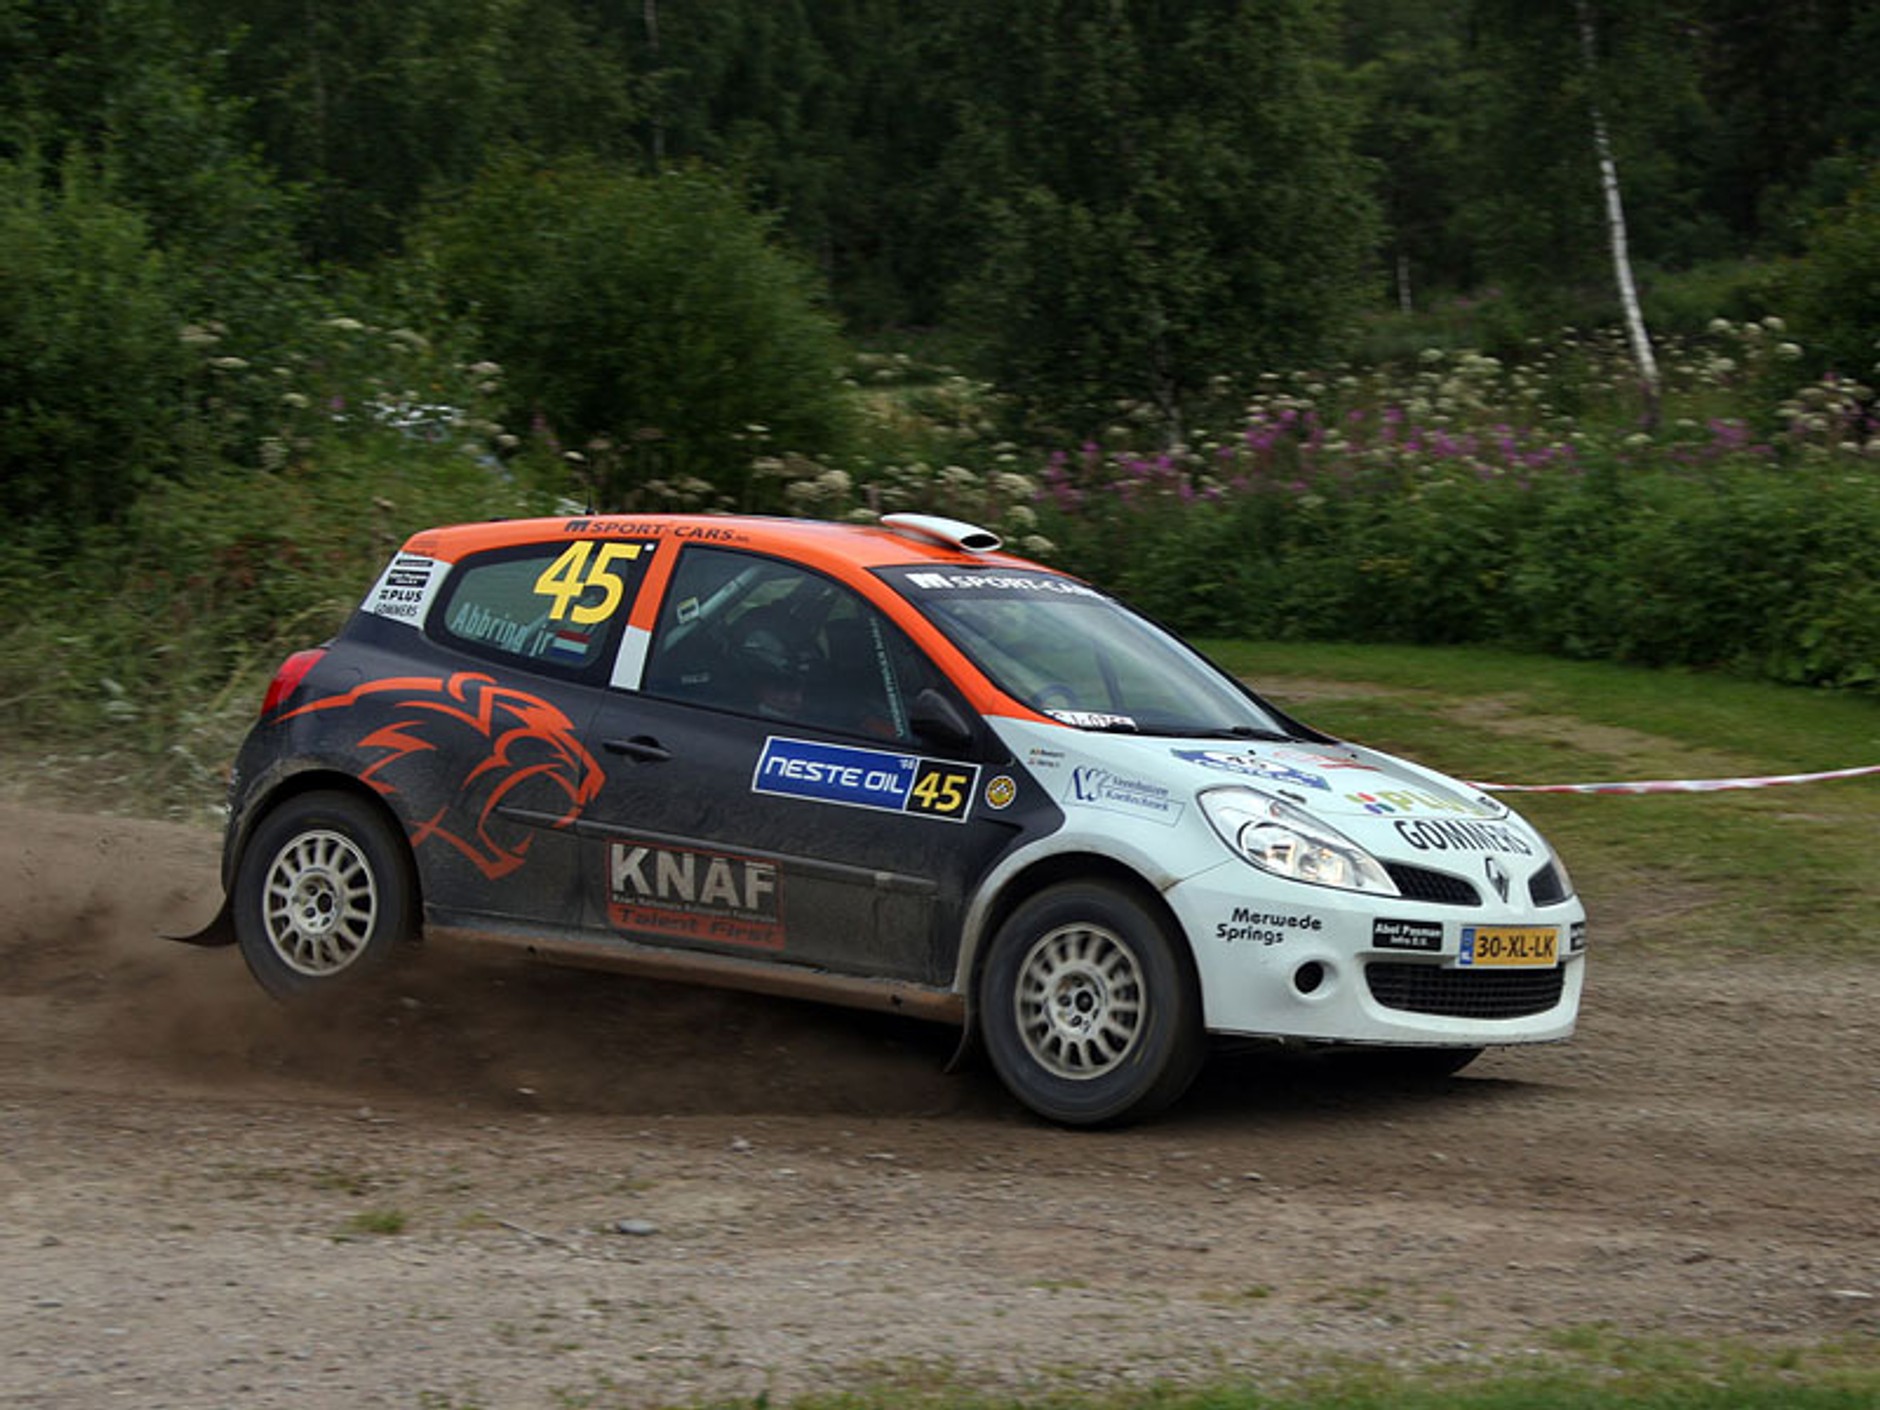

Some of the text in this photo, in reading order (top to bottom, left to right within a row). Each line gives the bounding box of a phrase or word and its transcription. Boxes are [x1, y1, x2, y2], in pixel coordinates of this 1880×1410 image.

[387, 589, 423, 602] PLUS
[533, 540, 642, 625] 45
[764, 756, 863, 787] NESTE
[863, 771, 904, 795] OIL
[912, 771, 967, 812] 45
[1394, 820, 1532, 856] GOMMERS
[611, 843, 777, 910] KNAF
[1231, 907, 1323, 931] Merwede
[1216, 923, 1284, 946] Springs
[1476, 935, 1556, 958] 30-XL-LK
